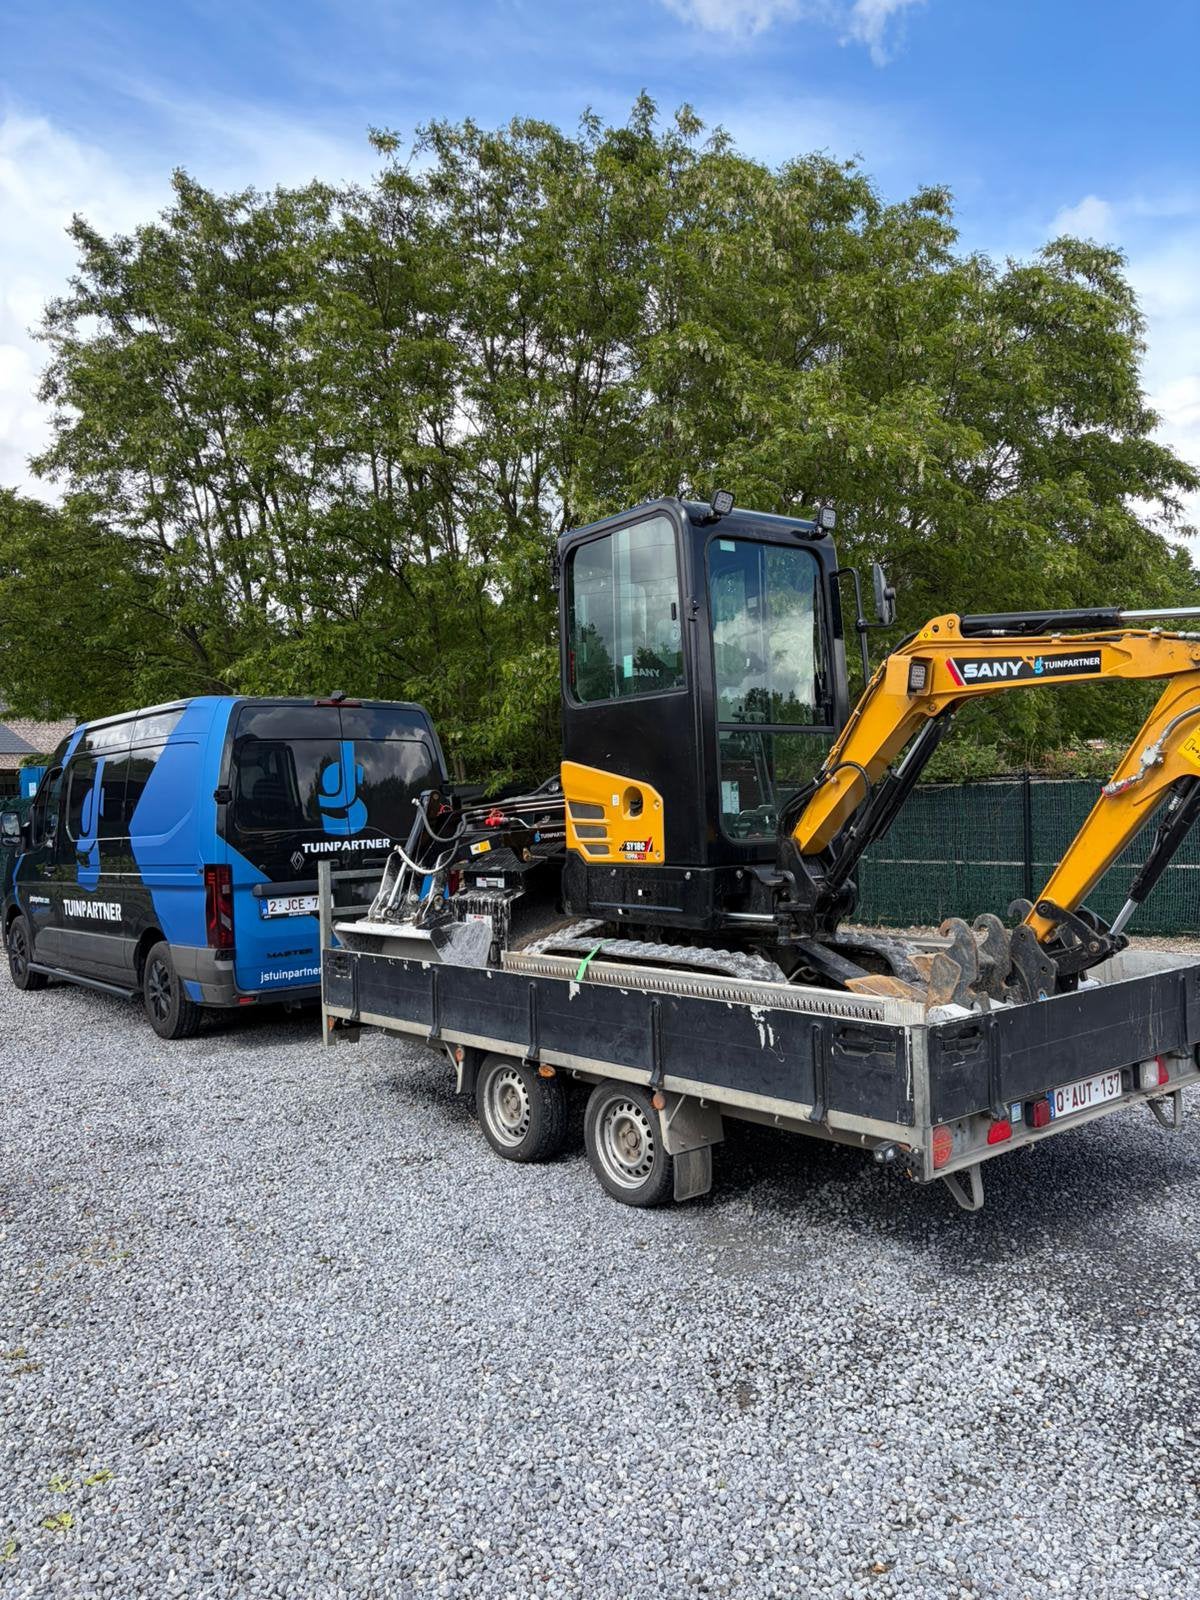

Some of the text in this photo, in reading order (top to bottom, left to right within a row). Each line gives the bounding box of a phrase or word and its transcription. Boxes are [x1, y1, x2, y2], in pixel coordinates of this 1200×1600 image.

[963, 660, 1024, 679] SANY
[1044, 656, 1101, 670] TUINPARTNER
[301, 838, 391, 854] TUINPARTNER
[62, 899, 122, 921] TUINPARTNER
[269, 897, 319, 913] 2-JCE-7
